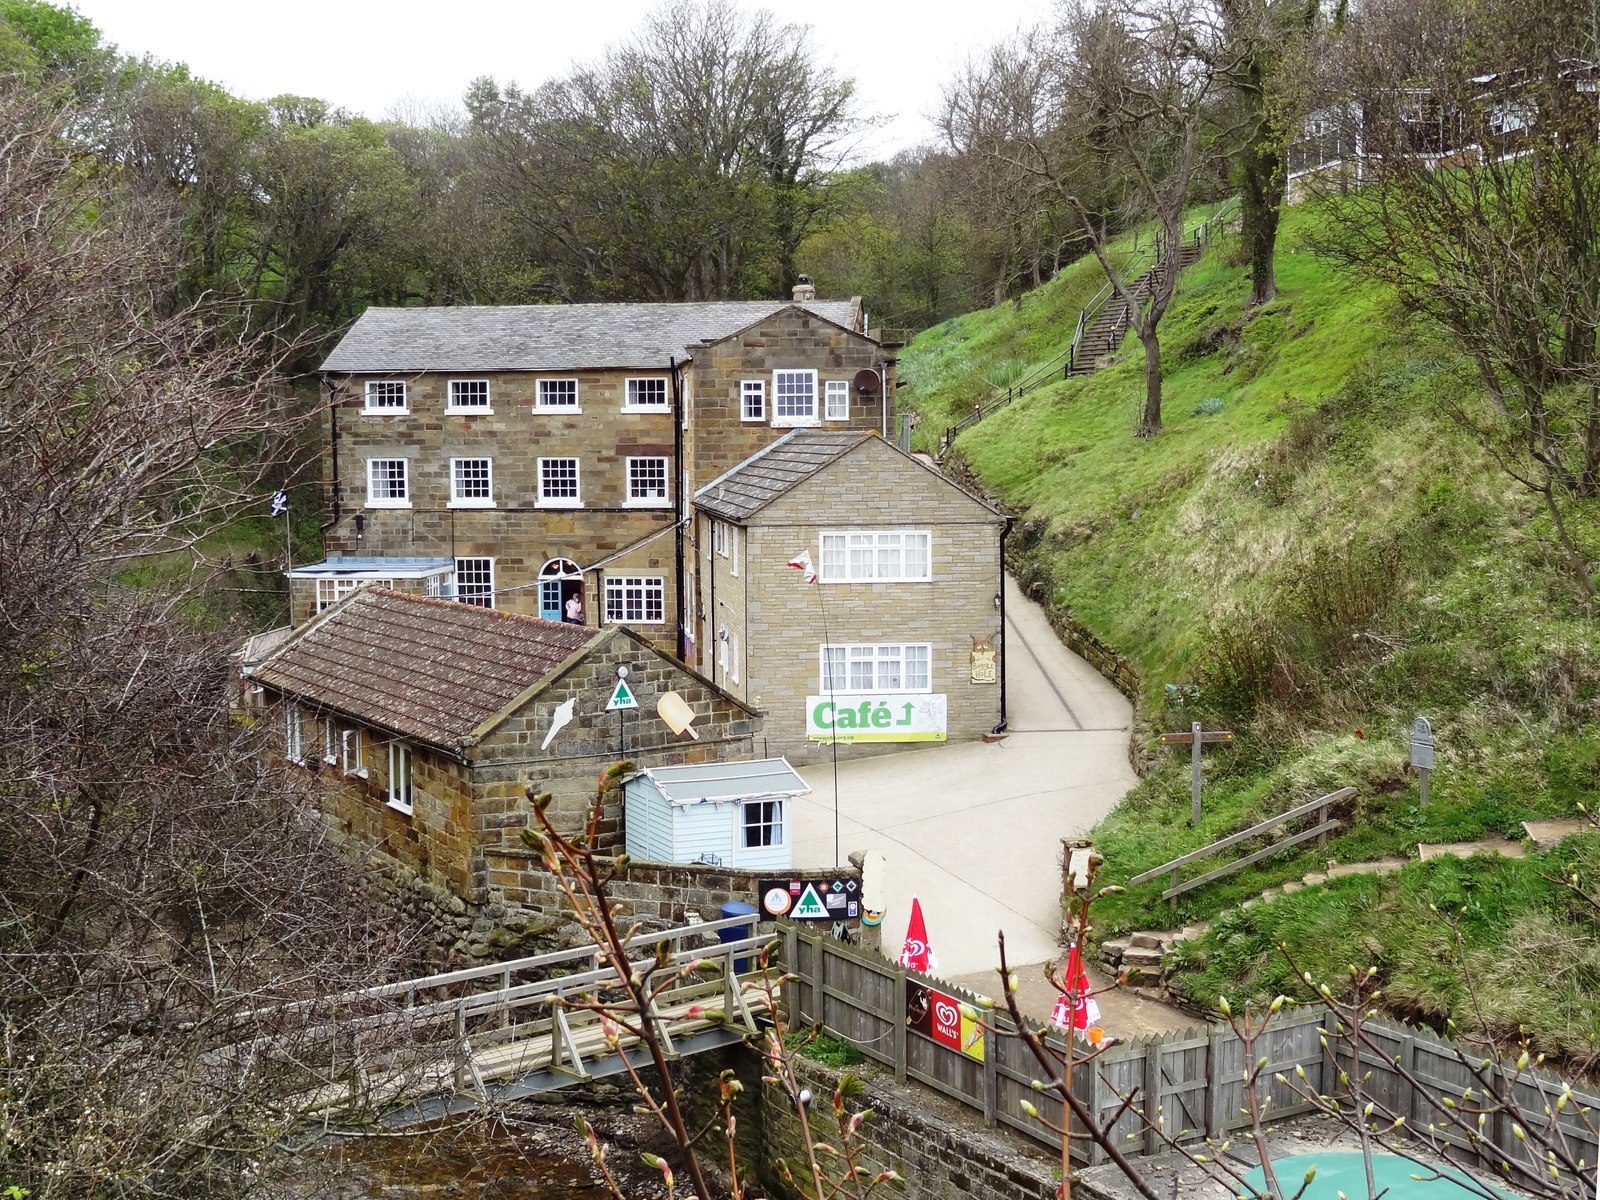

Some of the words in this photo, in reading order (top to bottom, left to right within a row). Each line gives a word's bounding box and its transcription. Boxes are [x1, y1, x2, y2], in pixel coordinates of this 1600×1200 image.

[613, 697, 632, 706] yha
[812, 701, 892, 729] Café
[798, 905, 821, 914] yha
[936, 1023, 957, 1039] WALL'S
